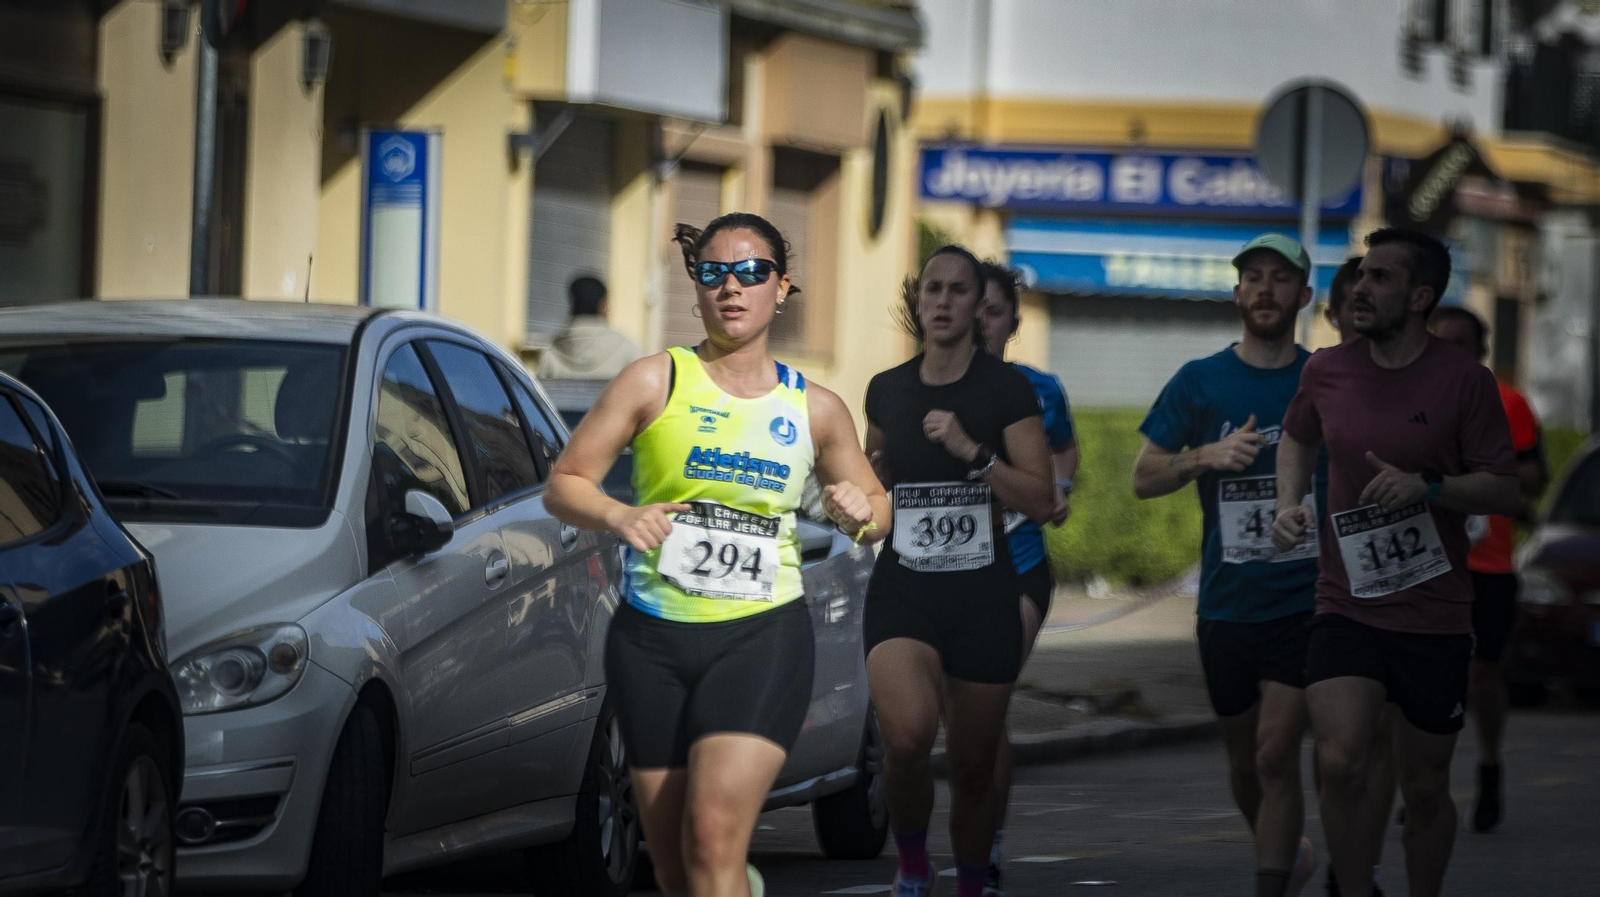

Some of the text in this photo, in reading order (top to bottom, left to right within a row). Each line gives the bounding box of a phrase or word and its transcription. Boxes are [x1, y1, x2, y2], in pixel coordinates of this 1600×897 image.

[1109, 156, 1162, 203] El
[684, 466, 786, 493] Ciudad de Jerez
[685, 446, 790, 480] Atletismo
[899, 496, 984, 508] POPULAR JEREZ
[678, 515, 775, 536] POPULAR JEREZ
[917, 514, 977, 547] 399
[688, 540, 762, 581] 294
[1364, 527, 1426, 570] 142
